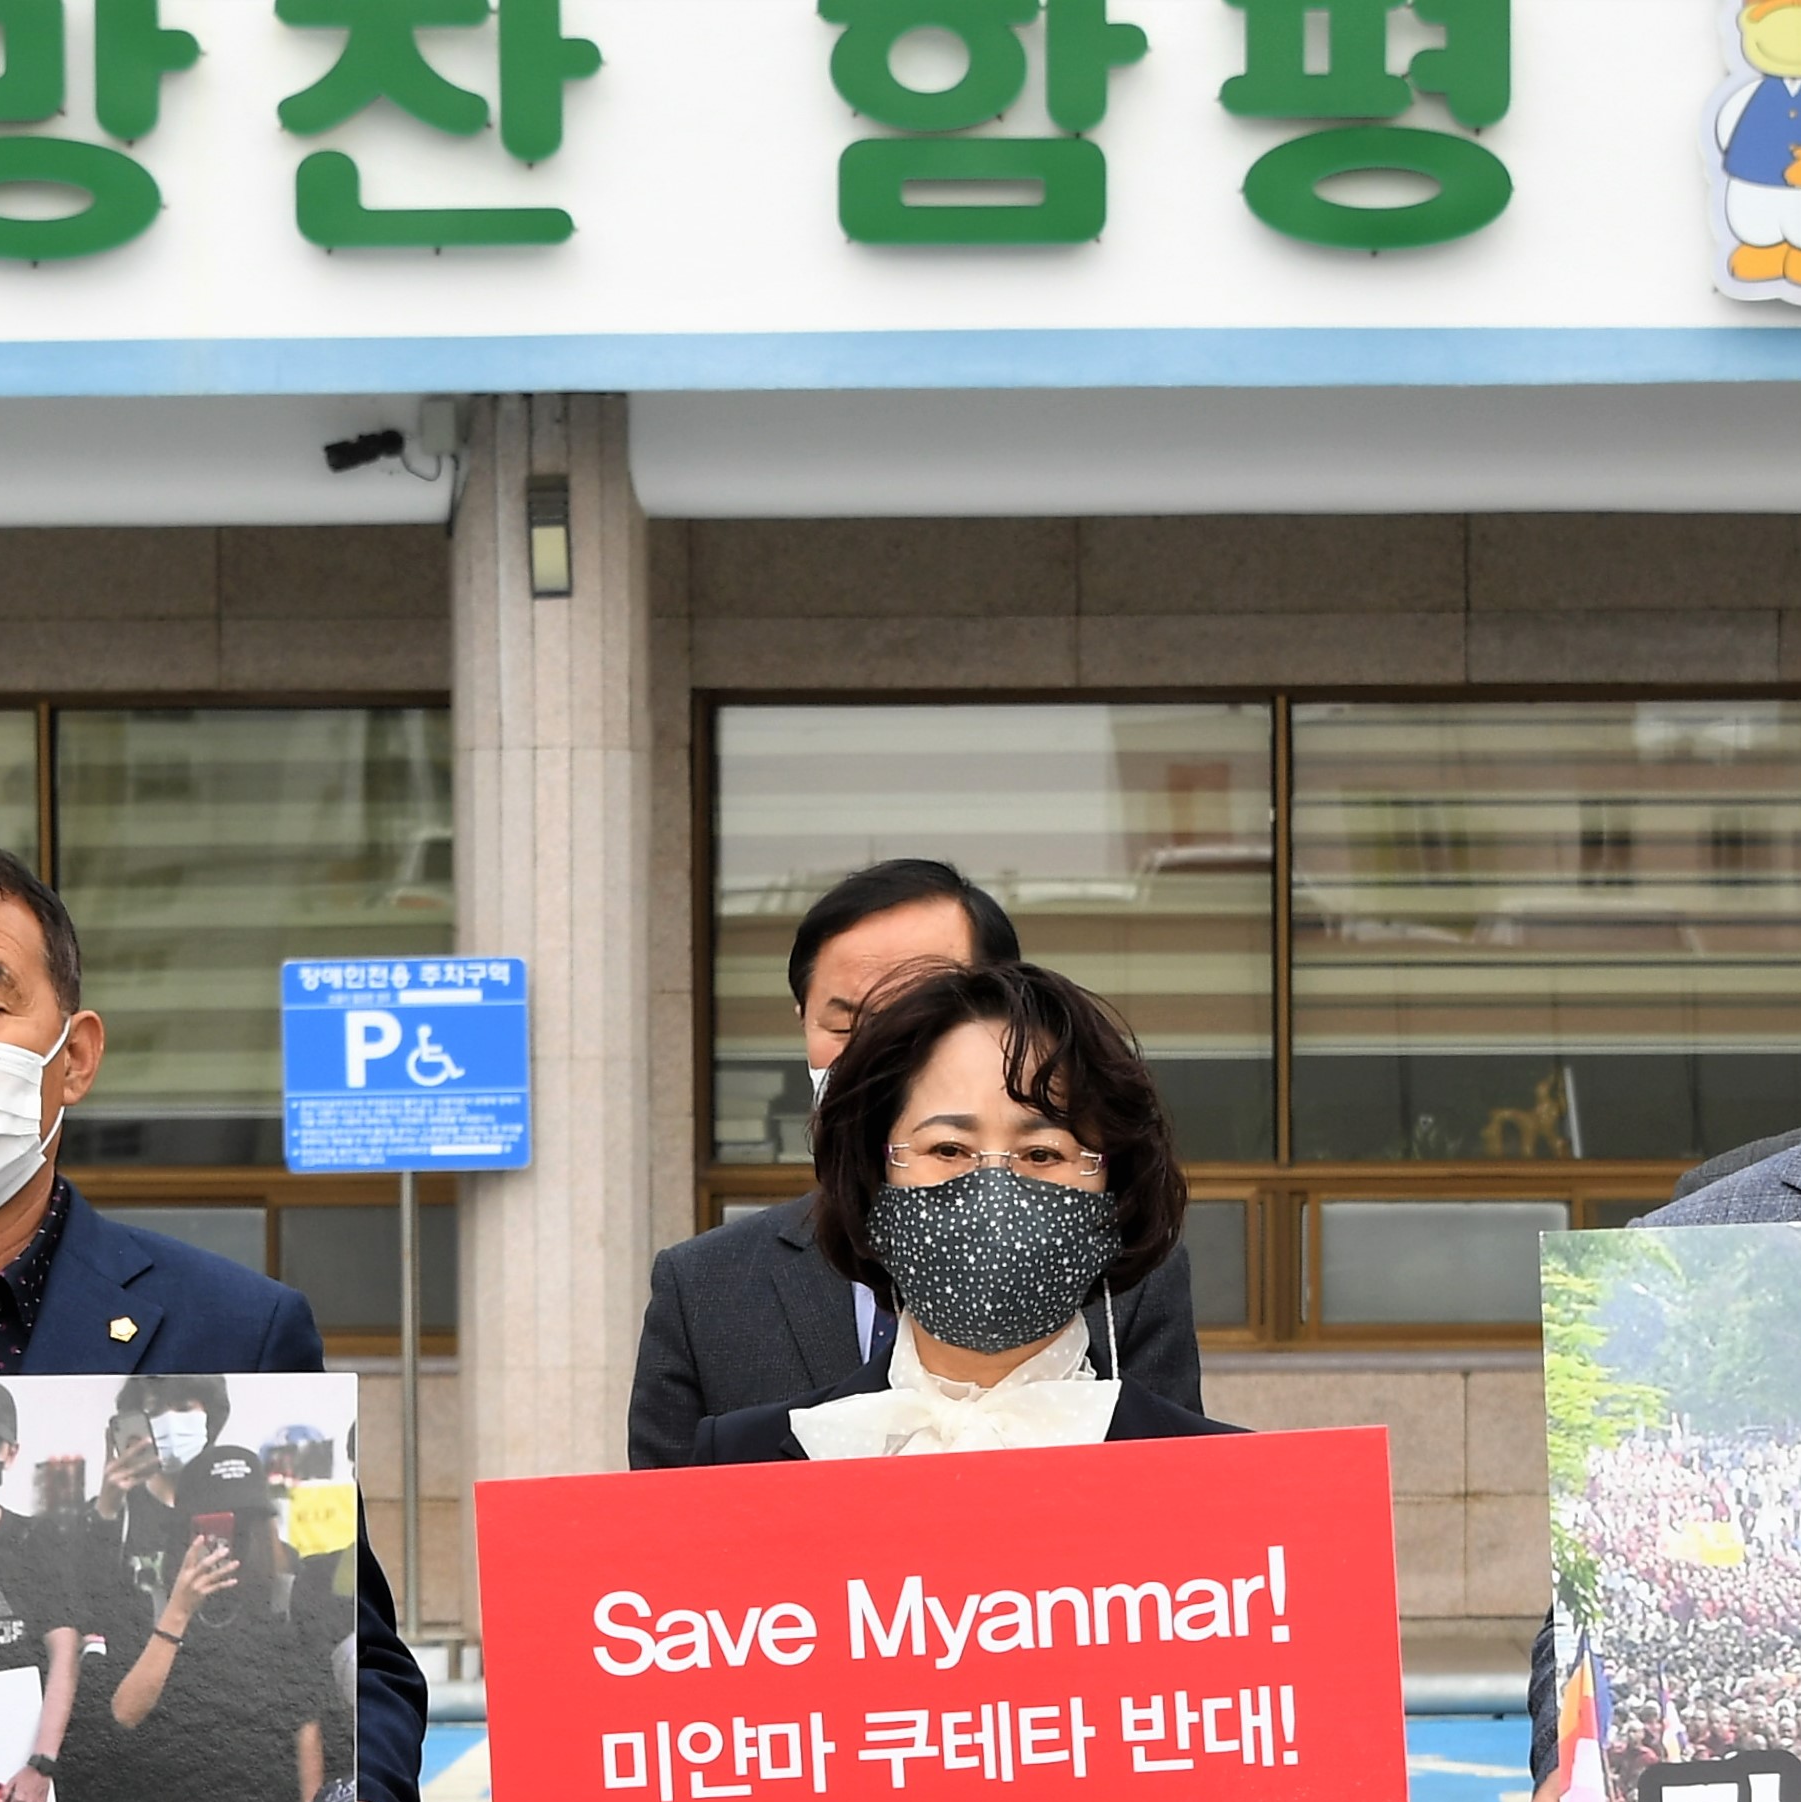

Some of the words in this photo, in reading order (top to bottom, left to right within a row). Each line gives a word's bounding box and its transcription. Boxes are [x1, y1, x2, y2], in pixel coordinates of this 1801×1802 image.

[826, 0, 1518, 252] 함평
[345, 1010, 401, 1088] P
[594, 1591, 816, 1675] Save
[848, 1546, 1289, 1669] Myanmar!
[603, 1713, 835, 1801] 미얀마
[859, 1697, 1095, 1788] 쿠테타
[1121, 1686, 1298, 1772] 반대!
